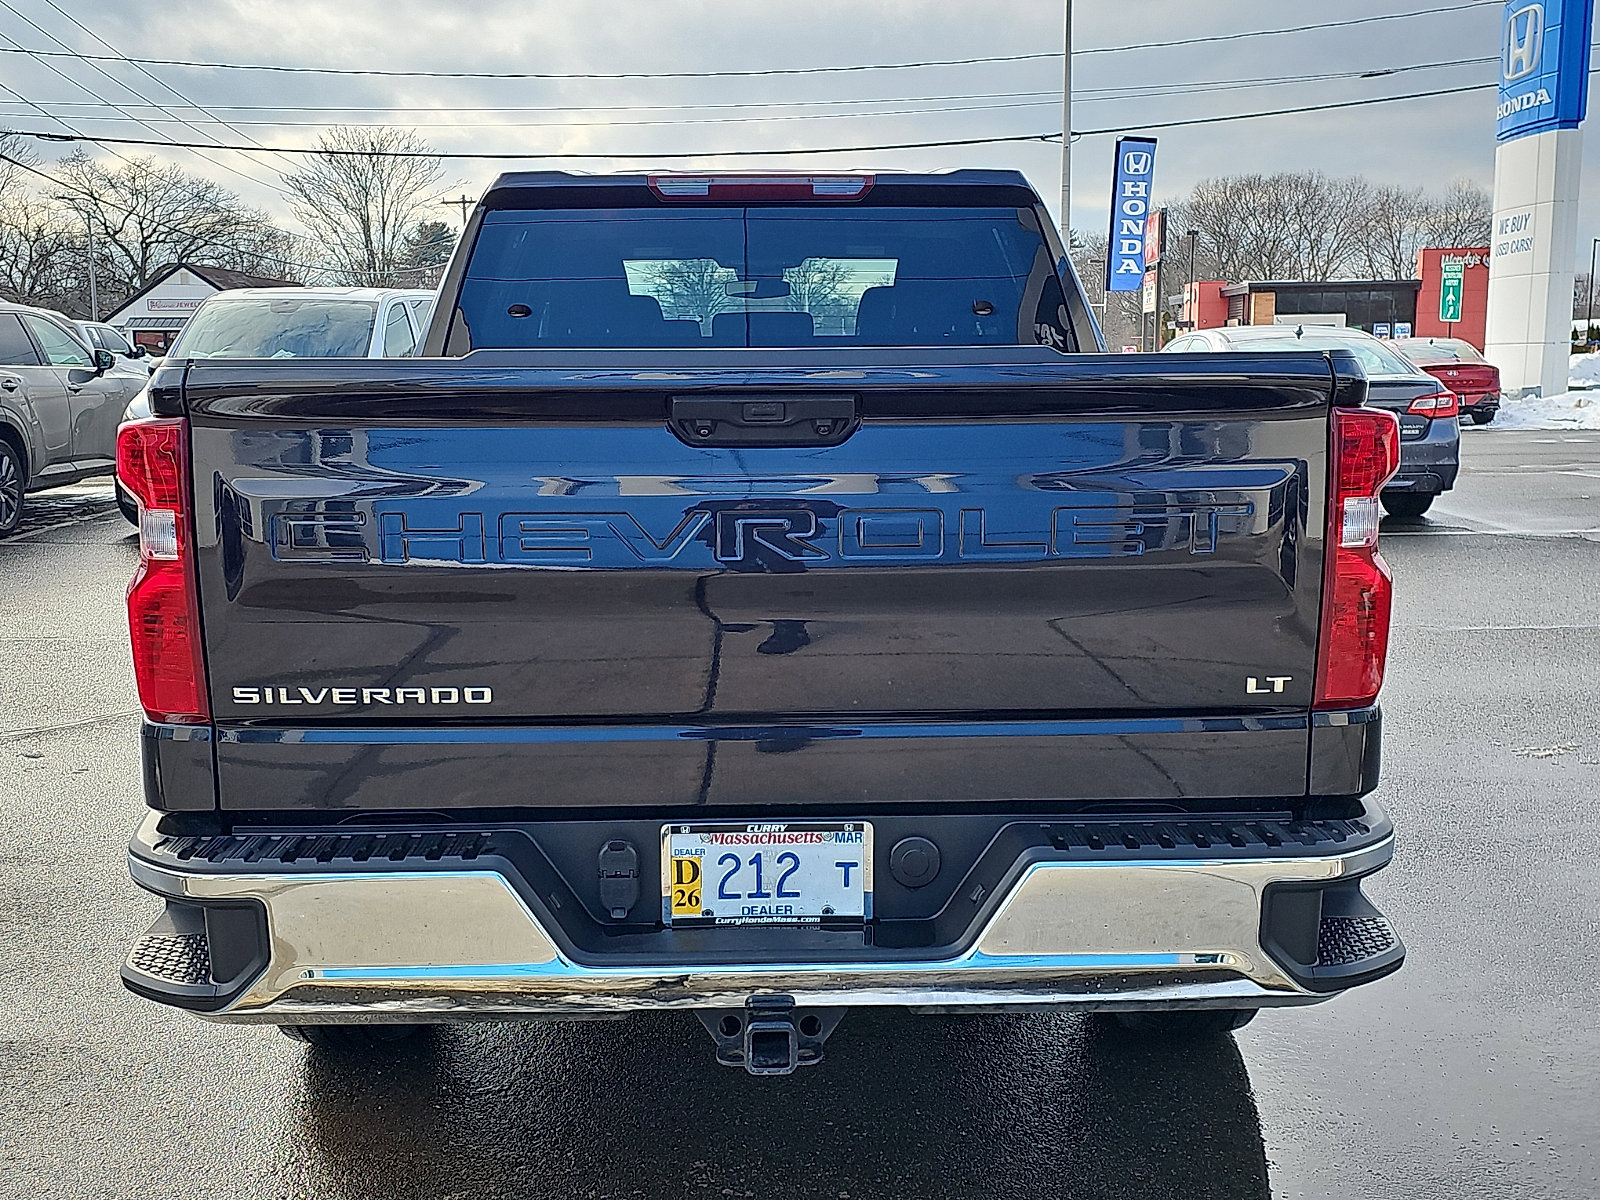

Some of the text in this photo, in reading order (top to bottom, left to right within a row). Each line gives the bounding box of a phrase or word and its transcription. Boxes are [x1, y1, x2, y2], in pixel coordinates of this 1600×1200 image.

[1496, 88, 1553, 121] HONDA
[1116, 181, 1148, 275] HONDA
[1510, 213, 1530, 233] BUY
[271, 502, 1253, 563] CHEVROLET
[1246, 675, 1293, 694] LT
[232, 686, 494, 704] SILVERADO
[746, 824, 788, 833] CURRY
[710, 832, 823, 845] Massachusetts
[834, 832, 863, 844] MAR
[673, 848, 706, 856] DEALER
[673, 859, 700, 885] D
[717, 852, 859, 900] 212 T
[674, 890, 700, 907] 26
[741, 905, 793, 915] DEALER
[715, 916, 821, 925] CurryHondaMass.com
